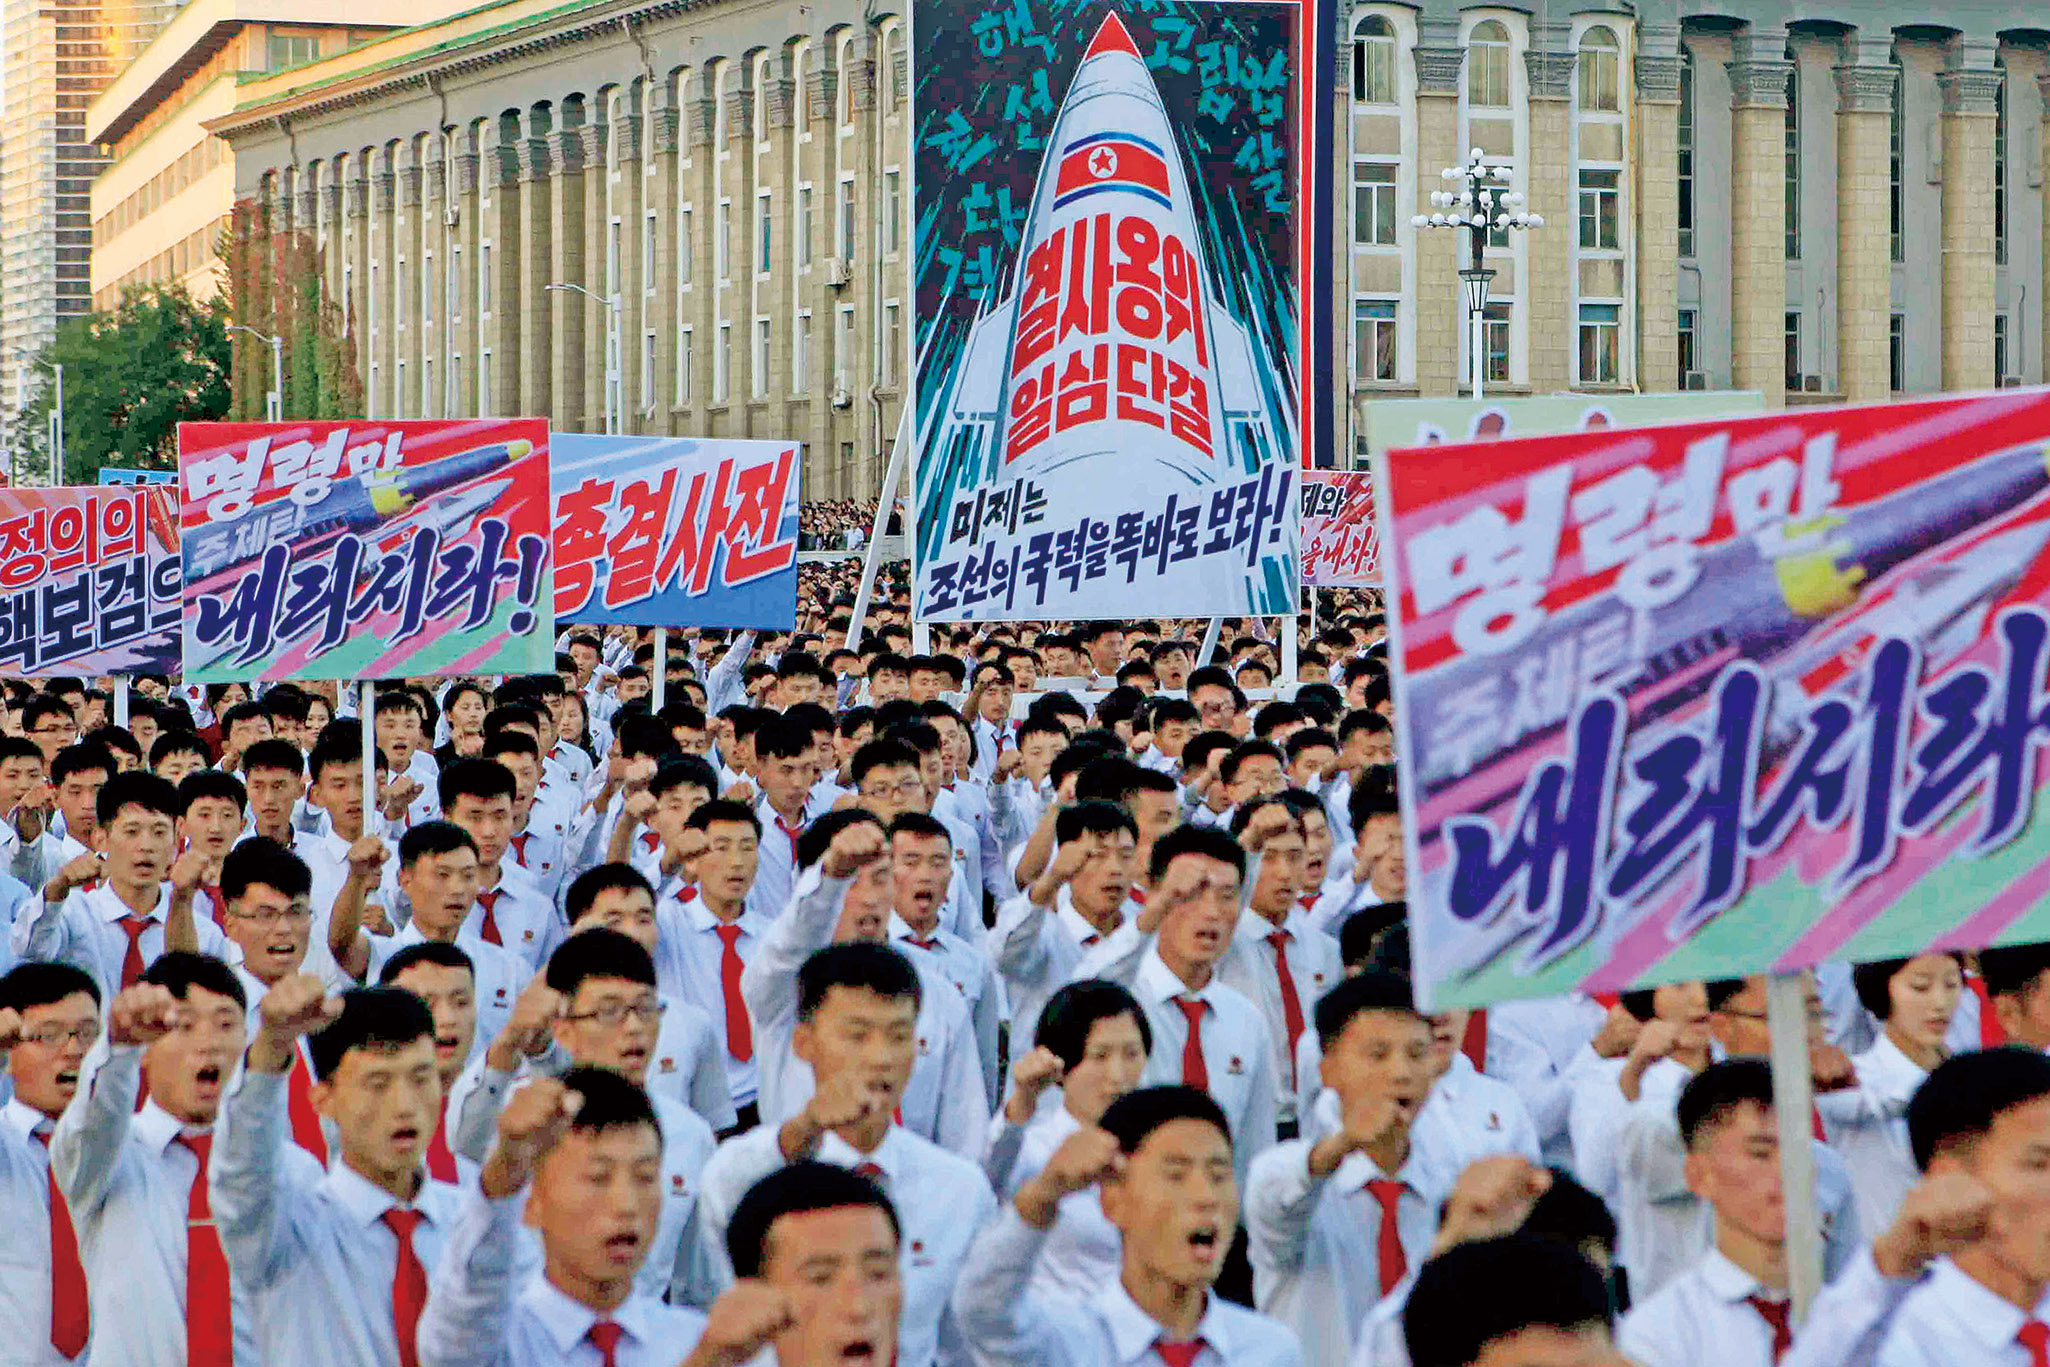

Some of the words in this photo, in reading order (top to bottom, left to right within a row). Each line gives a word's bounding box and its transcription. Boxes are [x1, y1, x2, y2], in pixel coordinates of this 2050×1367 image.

[1012, 213, 1209, 380] 결사옹위
[1005, 343, 1214, 465] 일심단결
[0, 492, 147, 586] 정의의
[186, 428, 404, 522] 명령만
[922, 540, 1021, 617] 조선의
[1021, 517, 1111, 605] 국력을
[1110, 493, 1201, 584] 똑바로
[1202, 463, 1293, 567] 보라!
[950, 477, 1048, 547] 미제는
[195, 519, 544, 666] 내리시라!
[1403, 430, 1842, 656] 명령만
